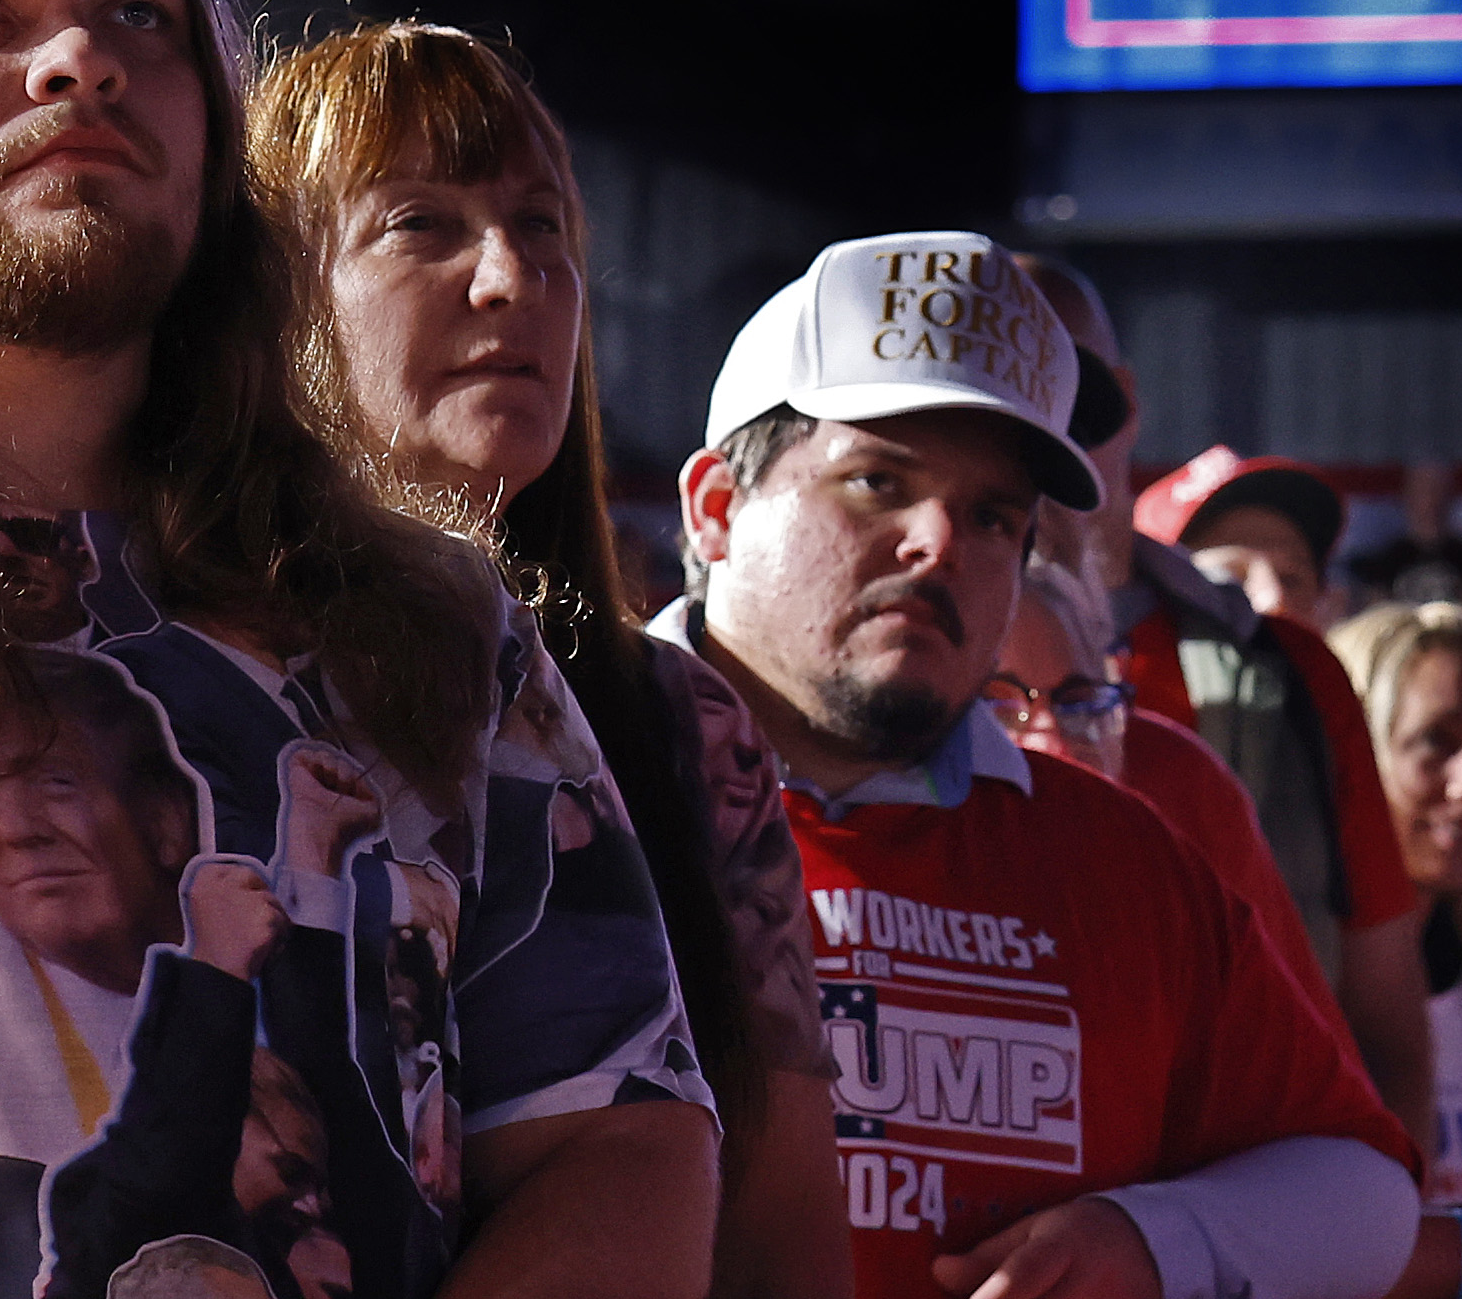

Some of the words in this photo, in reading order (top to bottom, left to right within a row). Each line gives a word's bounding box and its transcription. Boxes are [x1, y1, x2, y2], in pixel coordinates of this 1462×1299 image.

[811, 887, 1035, 971] WORKERS
[852, 950, 892, 978] FOR
[829, 1024, 1071, 1131] UMP
[838, 1153, 947, 1236] 024
